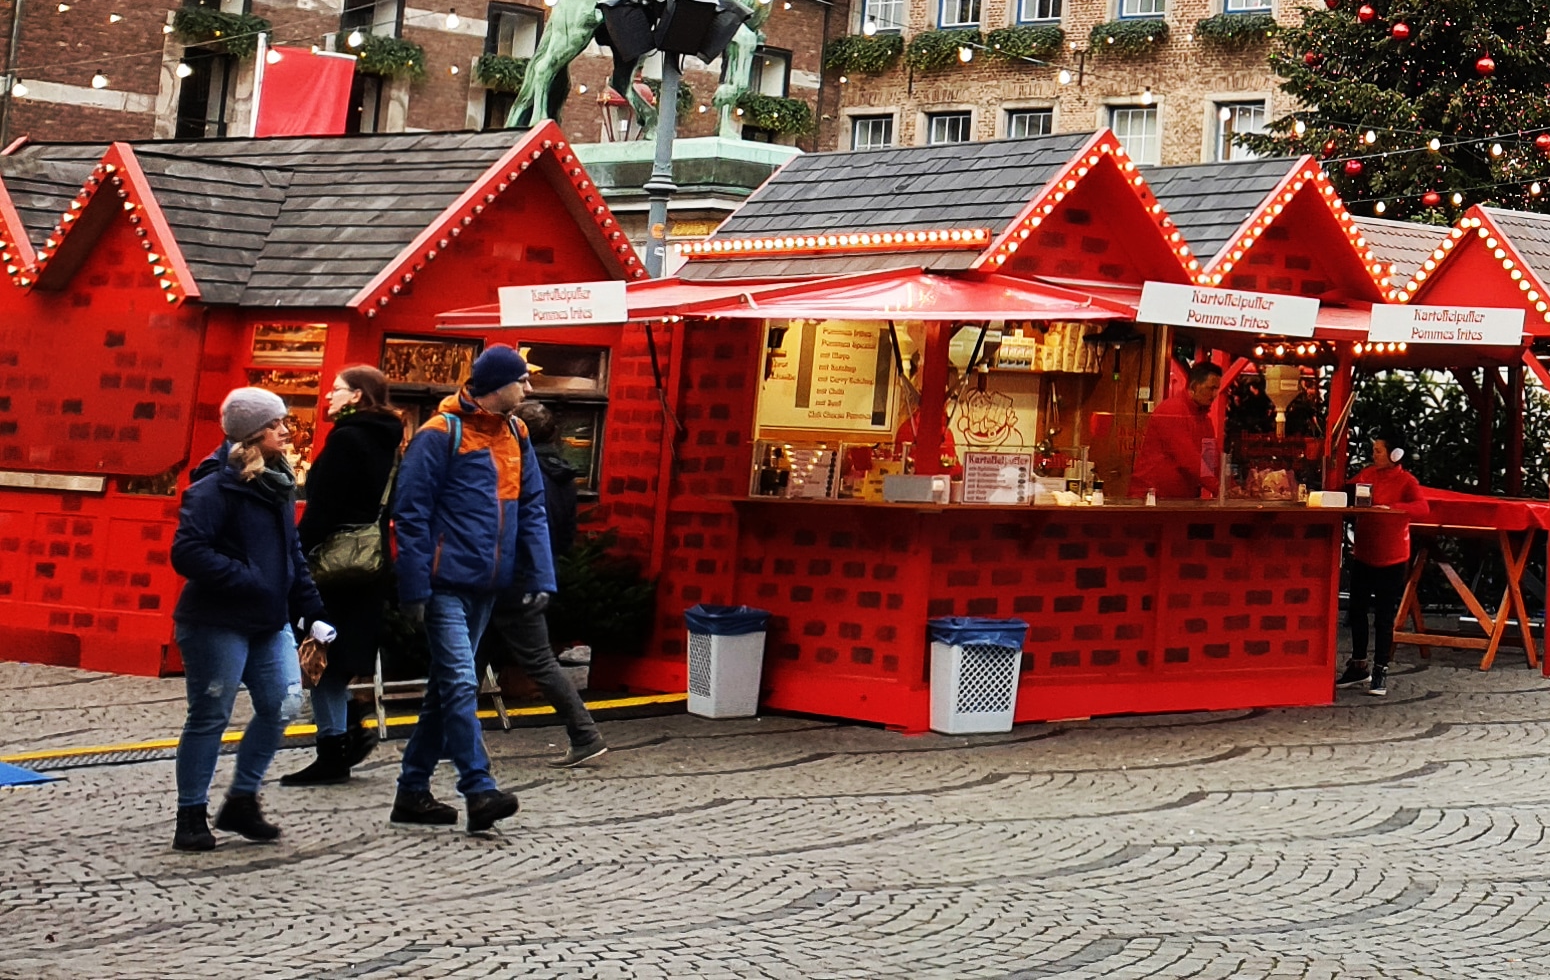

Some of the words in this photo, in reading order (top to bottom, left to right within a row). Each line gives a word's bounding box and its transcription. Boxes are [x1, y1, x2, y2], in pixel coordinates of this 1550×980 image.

[531, 286, 592, 303] Kartoffelpuffer
[1191, 289, 1275, 311] Kartoffelpuffer
[532, 308, 568, 321] Pommes
[1186, 309, 1237, 326] Pommes
[1239, 314, 1270, 330] frites
[1414, 308, 1485, 325] Kartoffelpuffer
[1411, 327, 1454, 341] Pommes
[1456, 328, 1483, 341] frites
